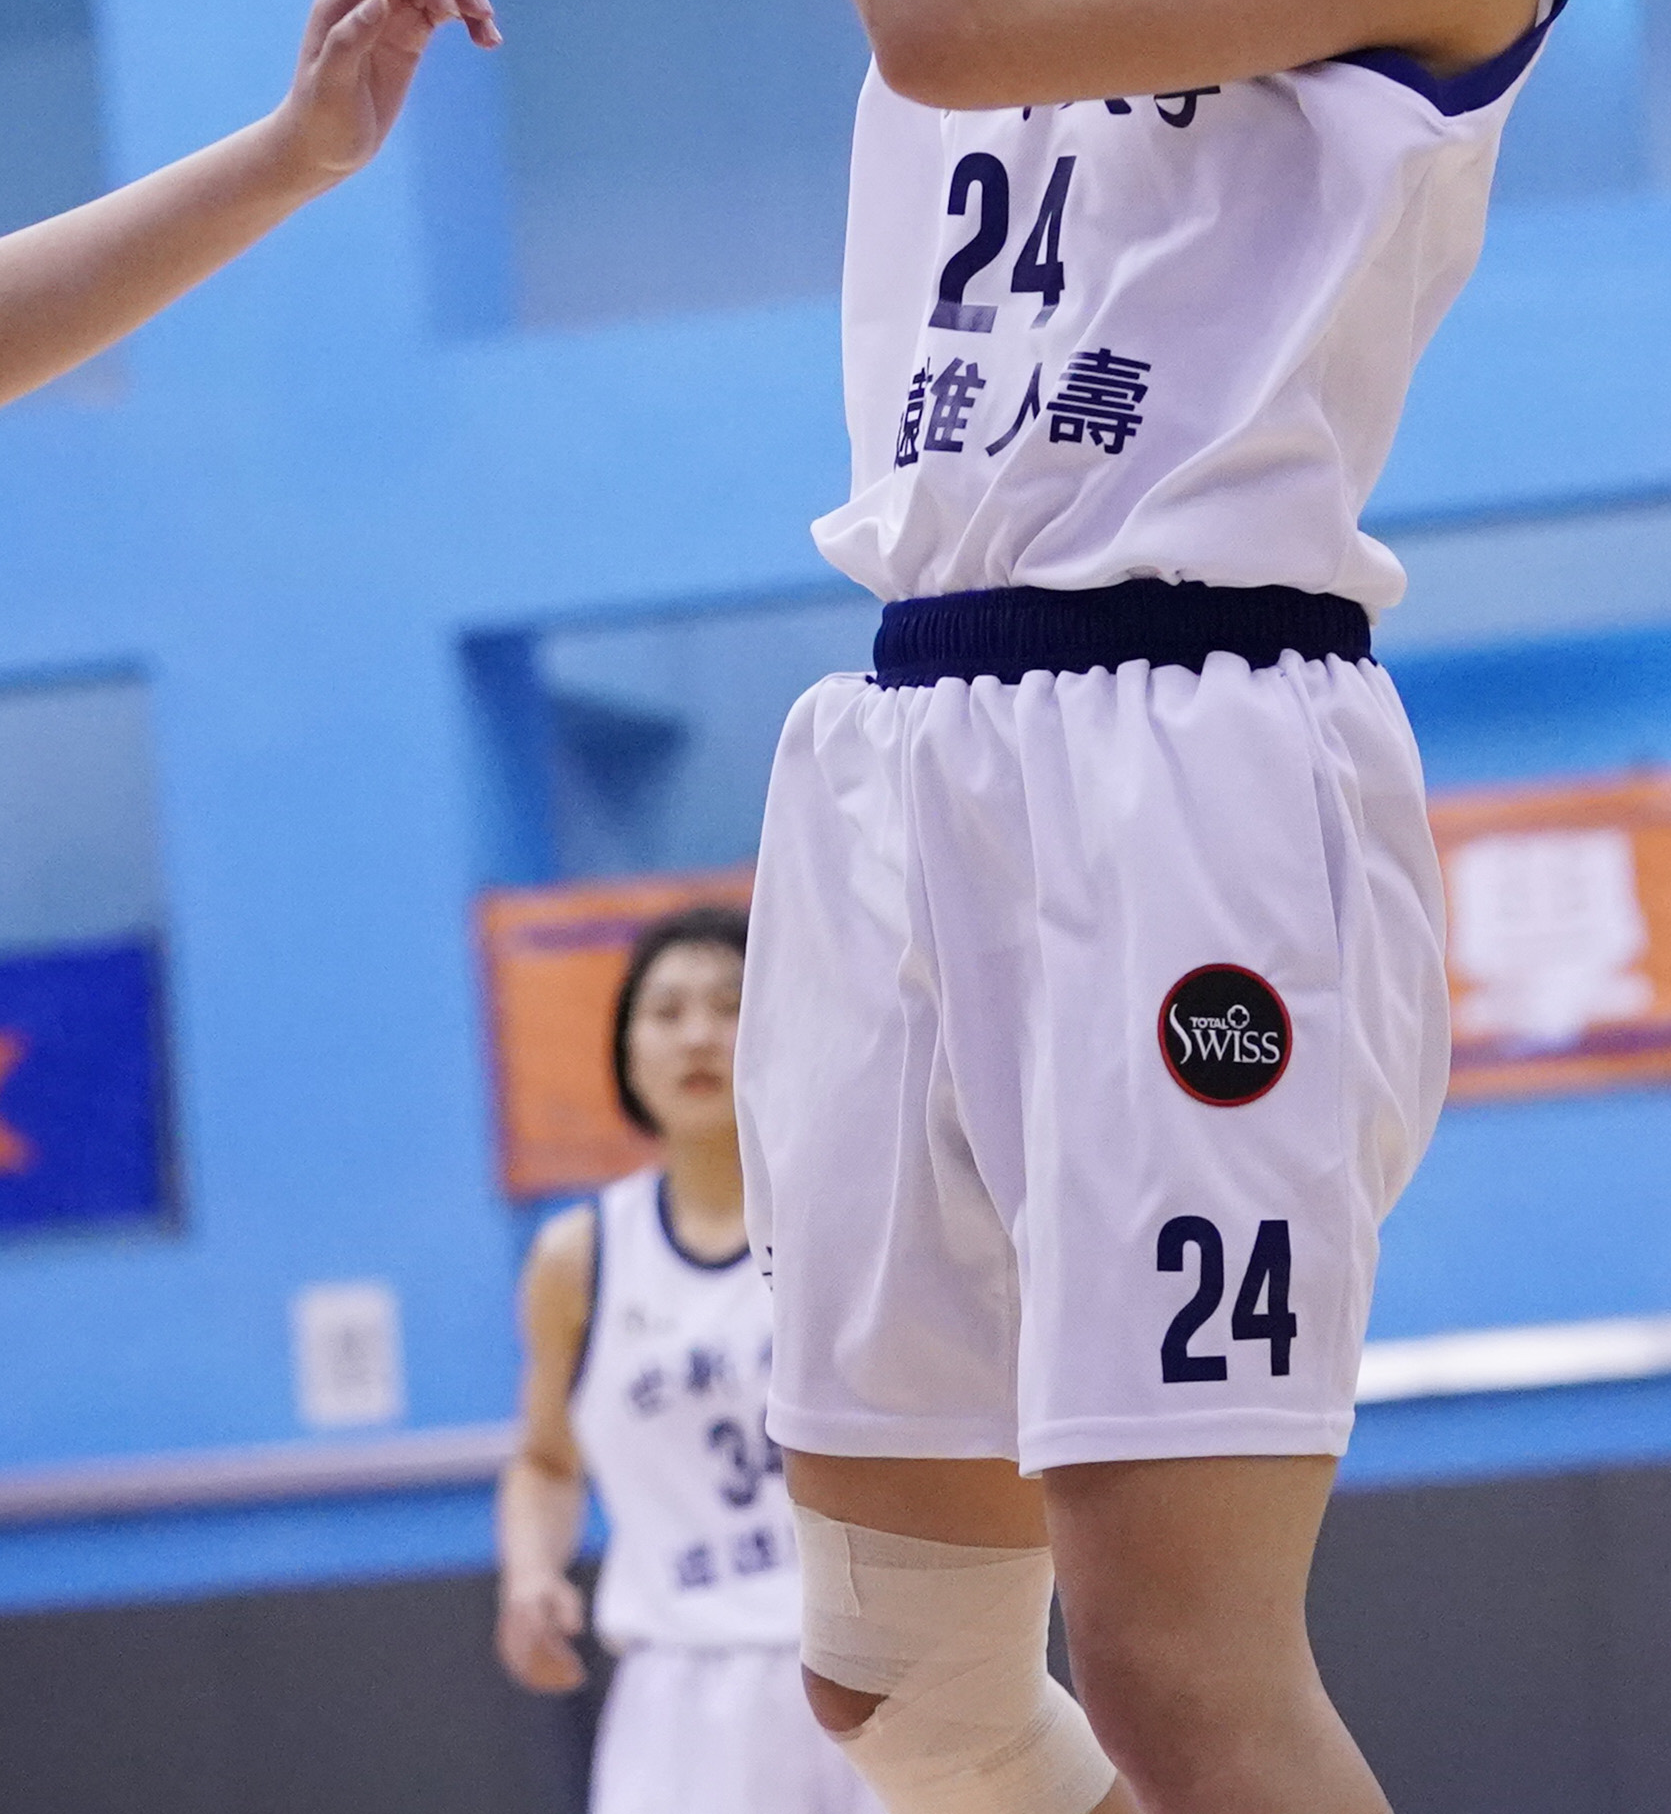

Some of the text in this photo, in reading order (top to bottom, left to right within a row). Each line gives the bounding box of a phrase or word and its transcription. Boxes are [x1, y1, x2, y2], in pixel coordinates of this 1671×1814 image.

[928, 151, 1077, 334] 24
[1169, 1003, 1281, 1065] SWISS
[1189, 1016, 1229, 1030] TOTAL
[1156, 1214, 1298, 1383] 24
[706, 1414, 784, 1509] 3
